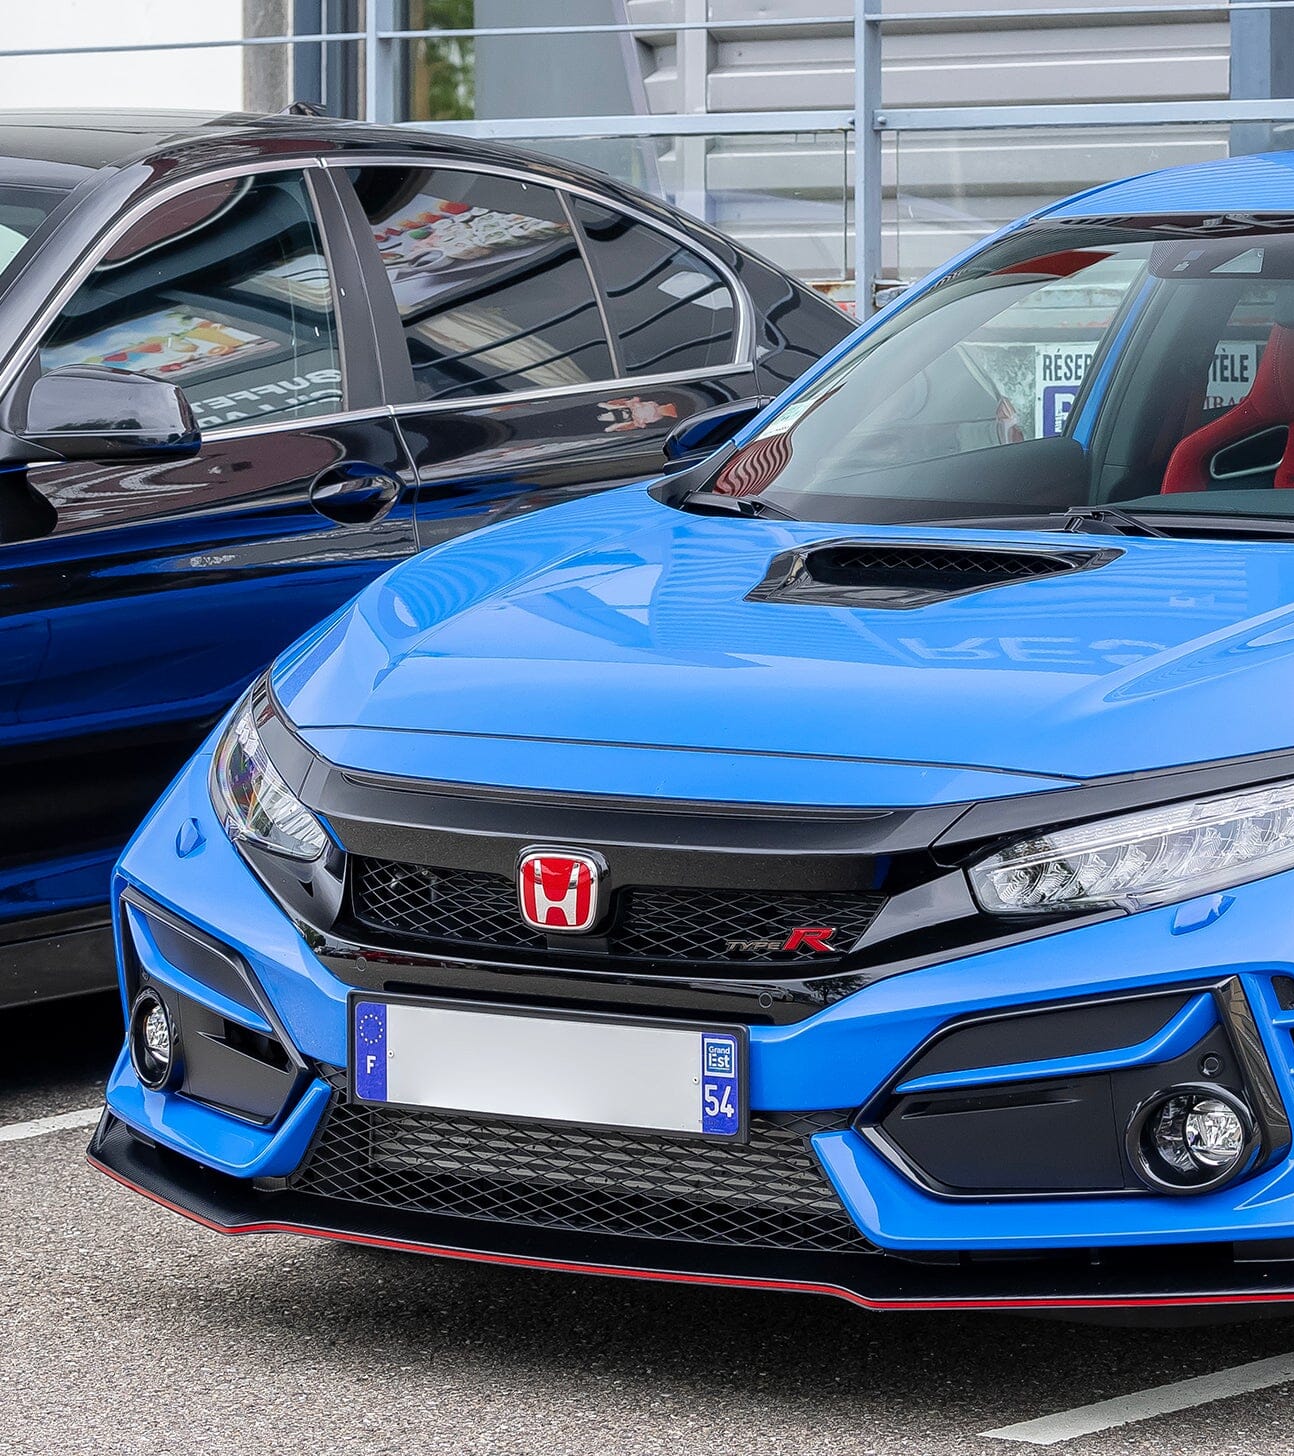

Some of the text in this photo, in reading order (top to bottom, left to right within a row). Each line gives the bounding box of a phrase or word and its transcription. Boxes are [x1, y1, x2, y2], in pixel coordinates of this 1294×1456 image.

[725, 926, 838, 953] TYPE R
[708, 1045, 731, 1055] Grand
[366, 1055, 376, 1074] F
[708, 1053, 731, 1068] Est
[703, 1083, 735, 1118] 54
